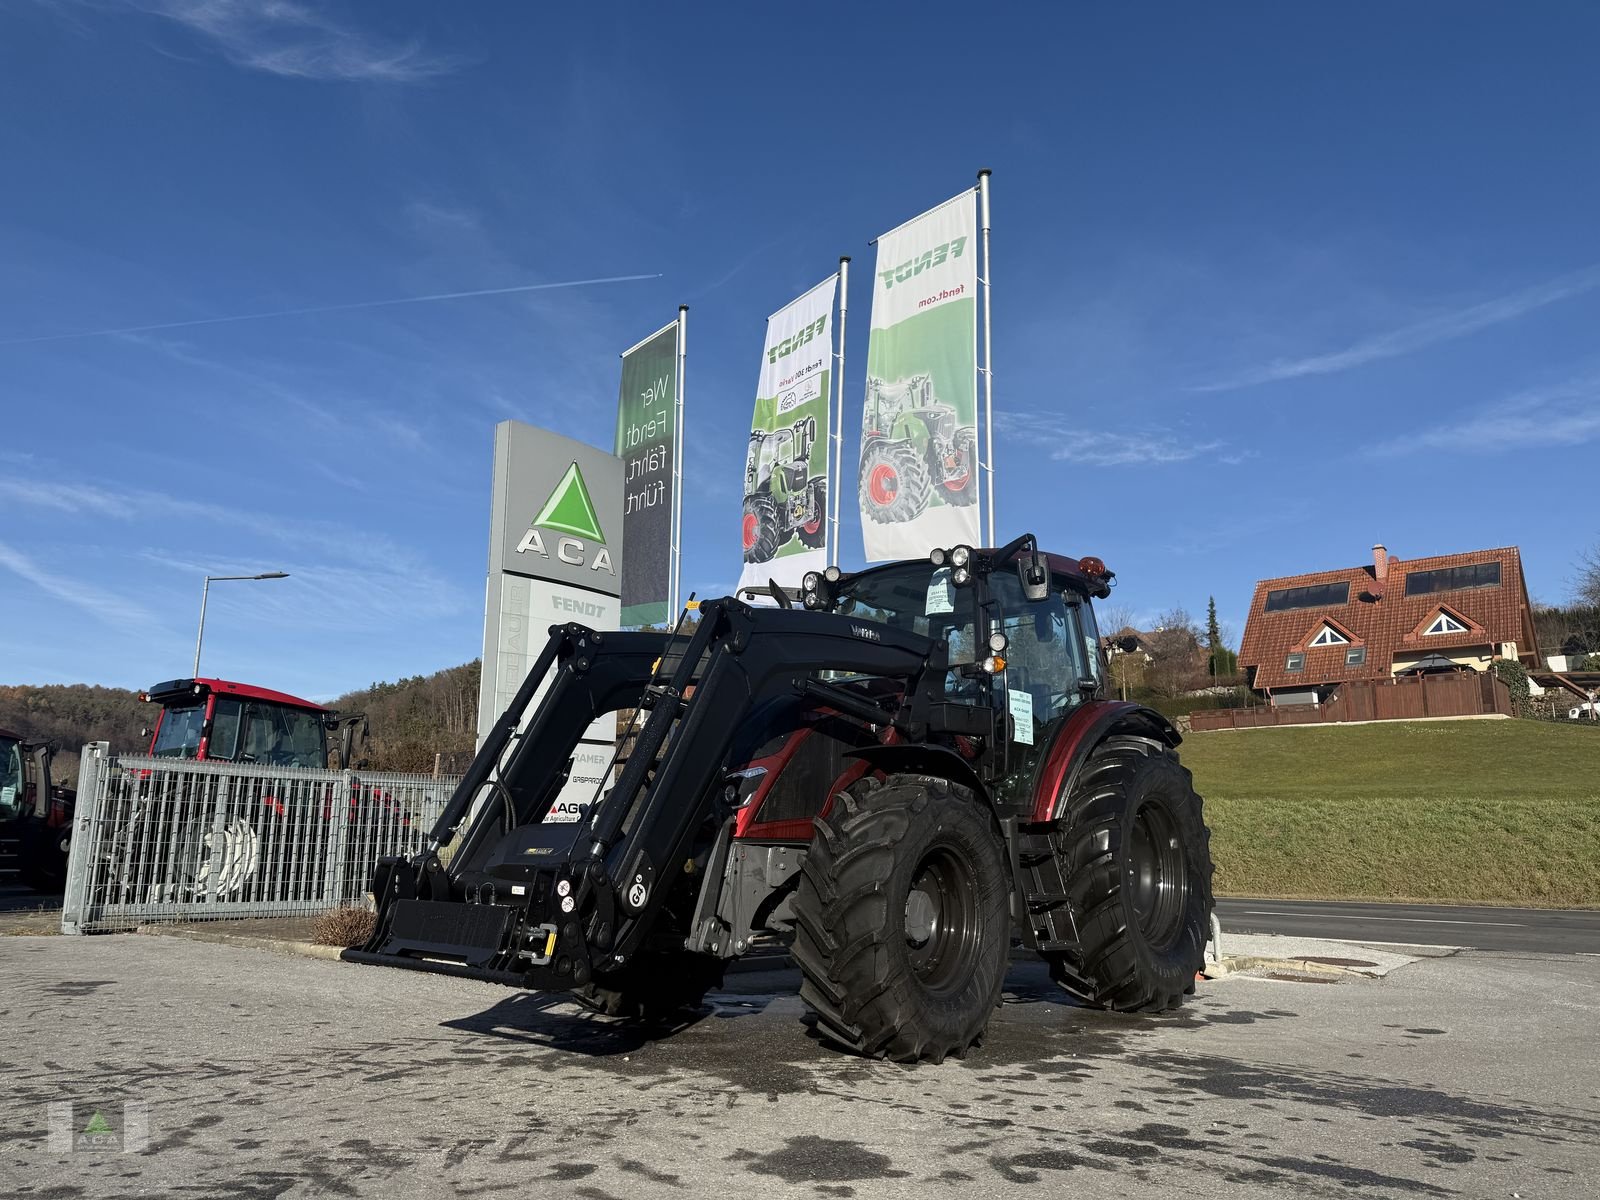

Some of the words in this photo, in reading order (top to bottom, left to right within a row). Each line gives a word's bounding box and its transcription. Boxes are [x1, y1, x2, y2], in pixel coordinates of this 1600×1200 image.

[514, 527, 616, 577] ACA
[551, 595, 606, 618] FENDT
[573, 753, 605, 765] RAMER
[632, 885, 644, 905] G4
